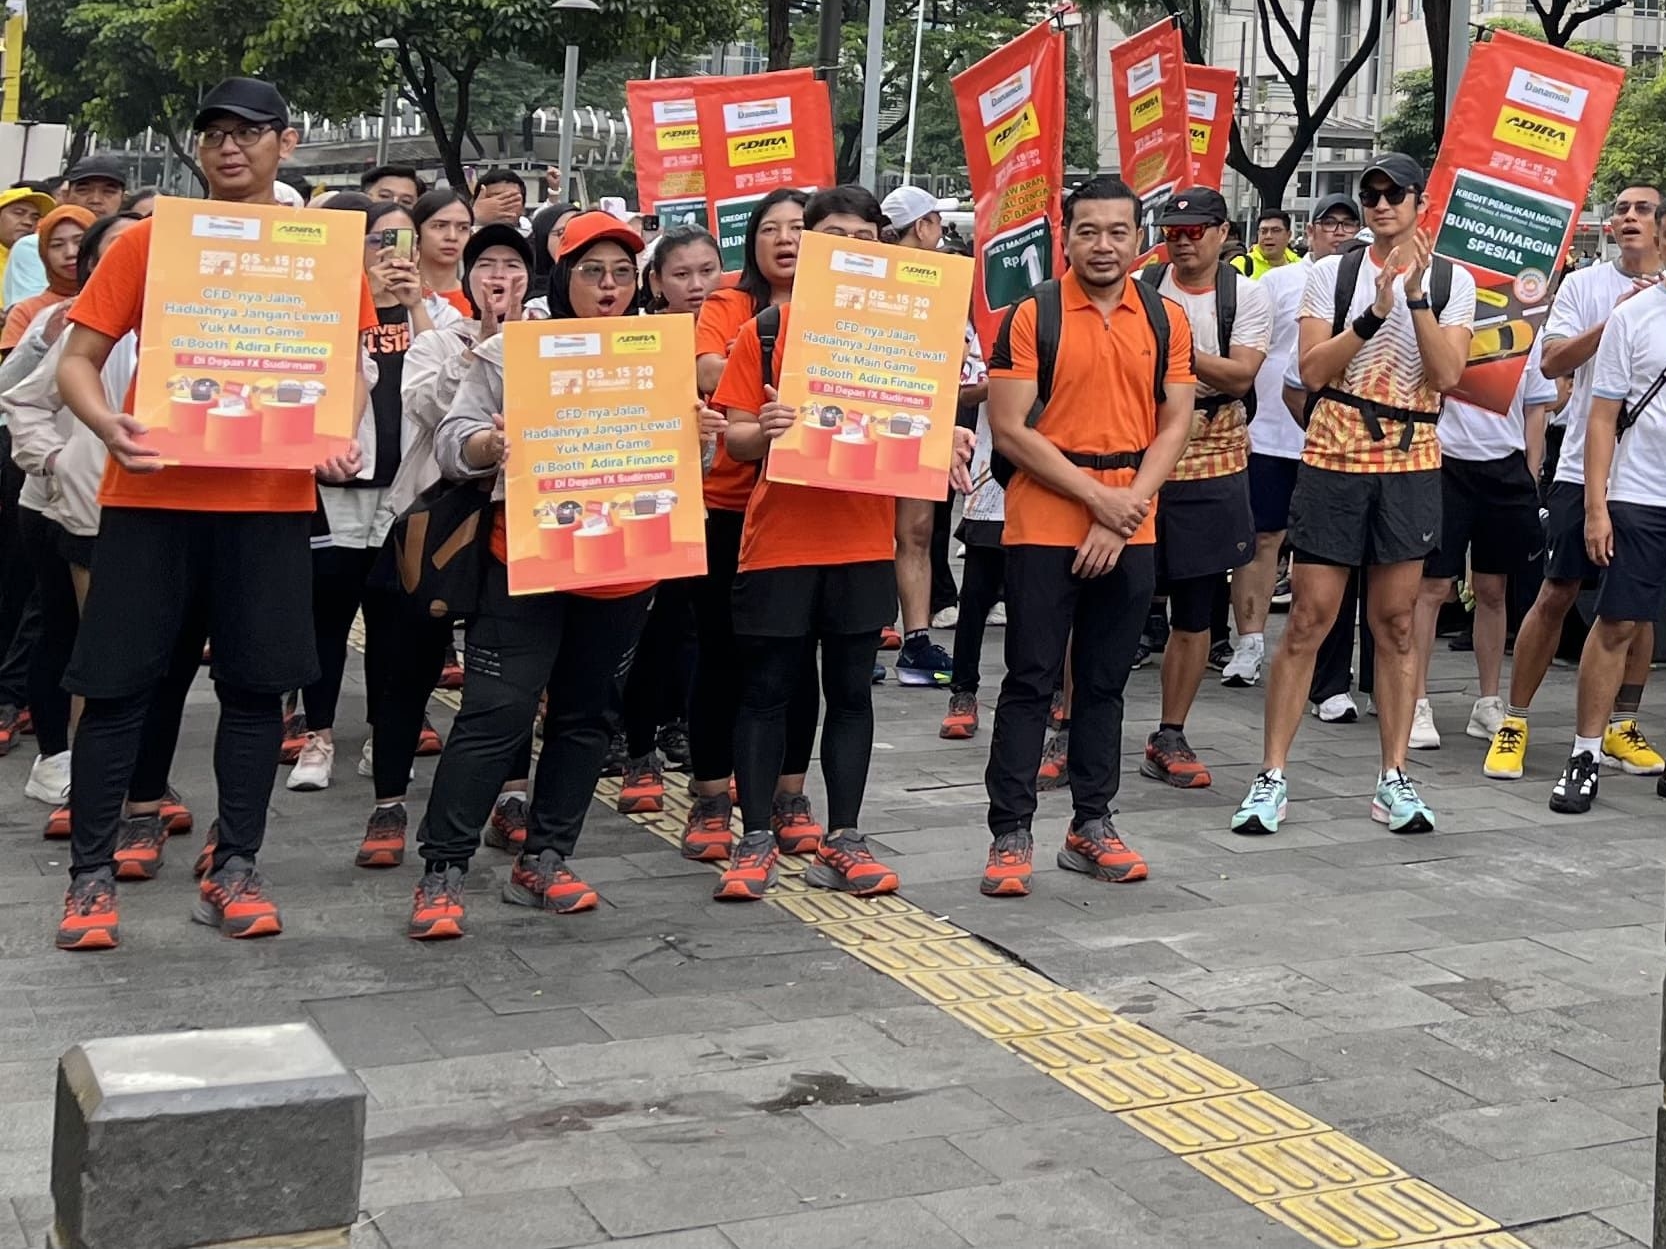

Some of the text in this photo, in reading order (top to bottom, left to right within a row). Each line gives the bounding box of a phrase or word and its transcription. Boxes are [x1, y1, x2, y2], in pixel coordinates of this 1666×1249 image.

[1505, 116, 1566, 141] ADIRA
[735, 136, 787, 151] ADIRA
[1455, 188, 1488, 205] KREDIT
[1487, 197, 1536, 220] PEMILIKAN
[1535, 212, 1564, 229] MOBIL
[1445, 213, 1558, 258] BUNGA/MARGIN
[240, 253, 261, 264] 05
[275, 255, 289, 265] 15
[295, 256, 315, 267] 20
[1466, 237, 1524, 265] SPESIAL
[1002, 256, 1020, 268] Rp
[295, 270, 313, 281] 26
[869, 289, 885, 300] 05
[897, 294, 909, 304] 15
[914, 297, 930, 308] 20
[164, 303, 340, 323] Hadiahnya Jangan Lewat!
[913, 309, 927, 320] 26
[200, 322, 304, 338] Yuk Main Game
[171, 337, 327, 355] di Booth Adira Finance
[803, 332, 945, 361] Hadiahnya Jangan Lewat!
[193, 355, 206, 364] Di
[207, 356, 245, 368] Depan
[262, 359, 316, 371] Sudirman
[831, 352, 916, 373] Yuk Main Game
[586, 369, 604, 378] 05
[616, 367, 631, 377] 15
[636, 366, 654, 377] 20
[807, 365, 935, 391] di Booth Adira Finance
[638, 379, 654, 390] 26
[824, 384, 834, 394] Di
[835, 385, 865, 398] Depan
[880, 392, 924, 405] Sudirman
[523, 419, 681, 439] Hadiahnya Jangan Lewat!
[556, 439, 651, 454] Yuk Main Game
[533, 453, 674, 473] di Booth Adira Finance
[554, 478, 566, 488] Di
[568, 476, 601, 488] Depan
[617, 471, 666, 483] Sudirman
